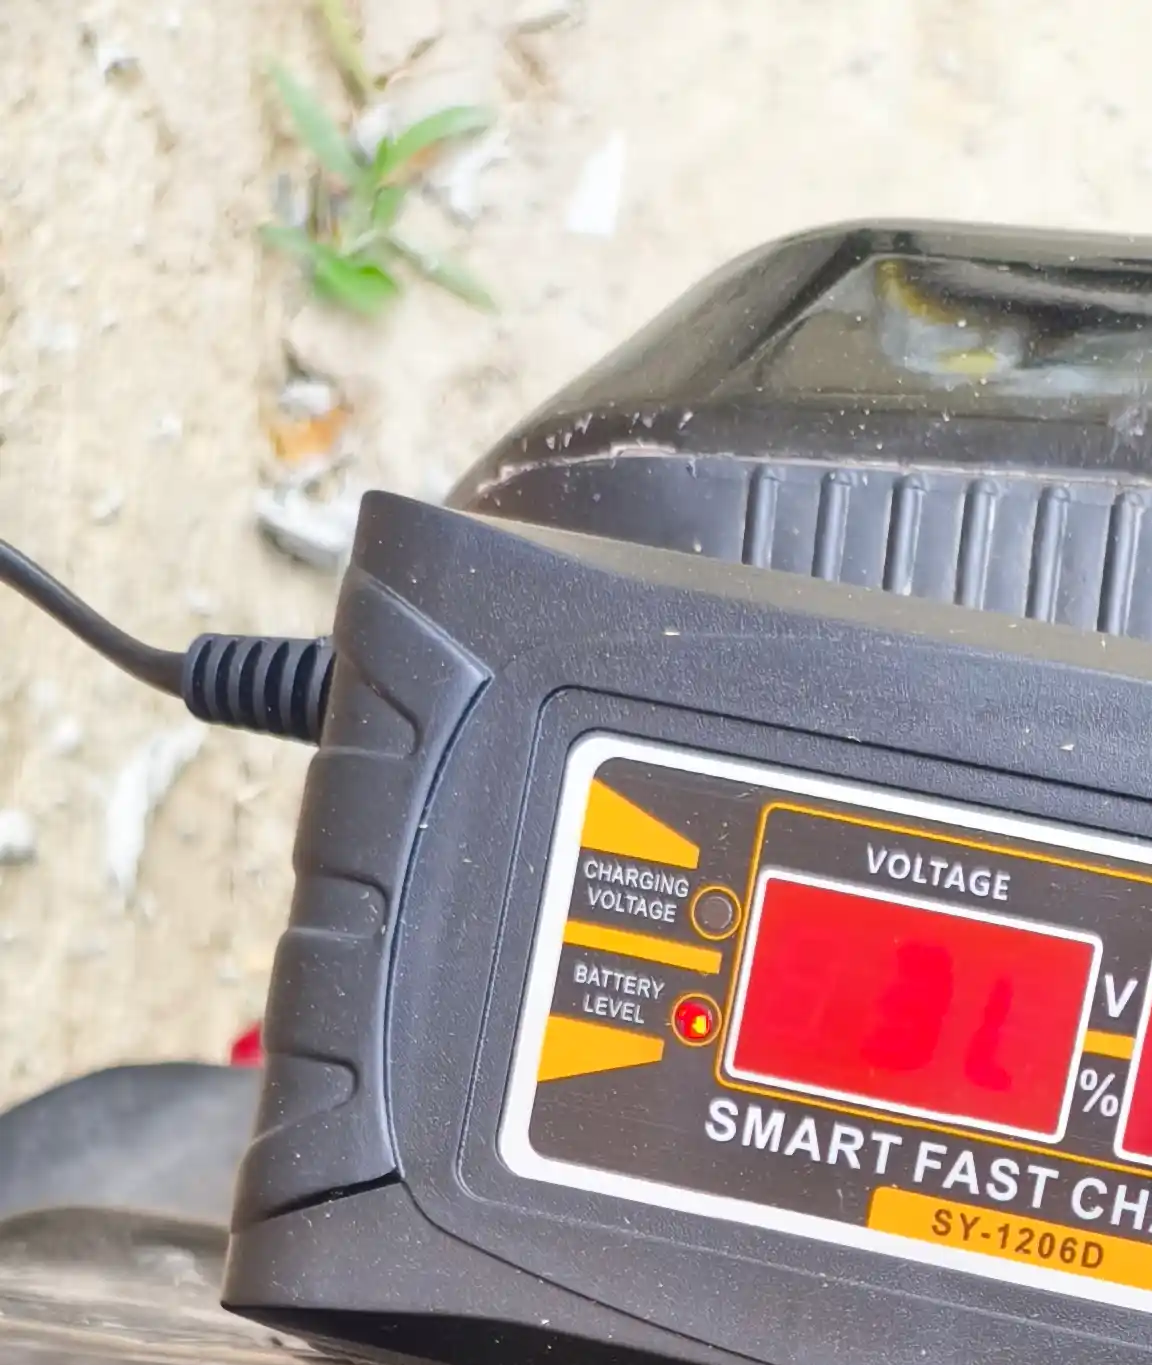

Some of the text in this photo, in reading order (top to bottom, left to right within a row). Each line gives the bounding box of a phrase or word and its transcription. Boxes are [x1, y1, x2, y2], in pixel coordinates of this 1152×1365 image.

[584, 859, 690, 899] CHARGING
[867, 844, 1010, 901] VOLTAGE
[588, 887, 677, 924] VOLTAGE
[574, 964, 665, 1000] BATTERY
[1104, 973, 1137, 1018] V
[584, 994, 645, 1024] LEVEL
[1080, 1068, 1120, 1117] %
[704, 1098, 903, 1176] SMART
[912, 1141, 1060, 1209] FAST
[931, 1208, 1105, 1270] SY-1206D
